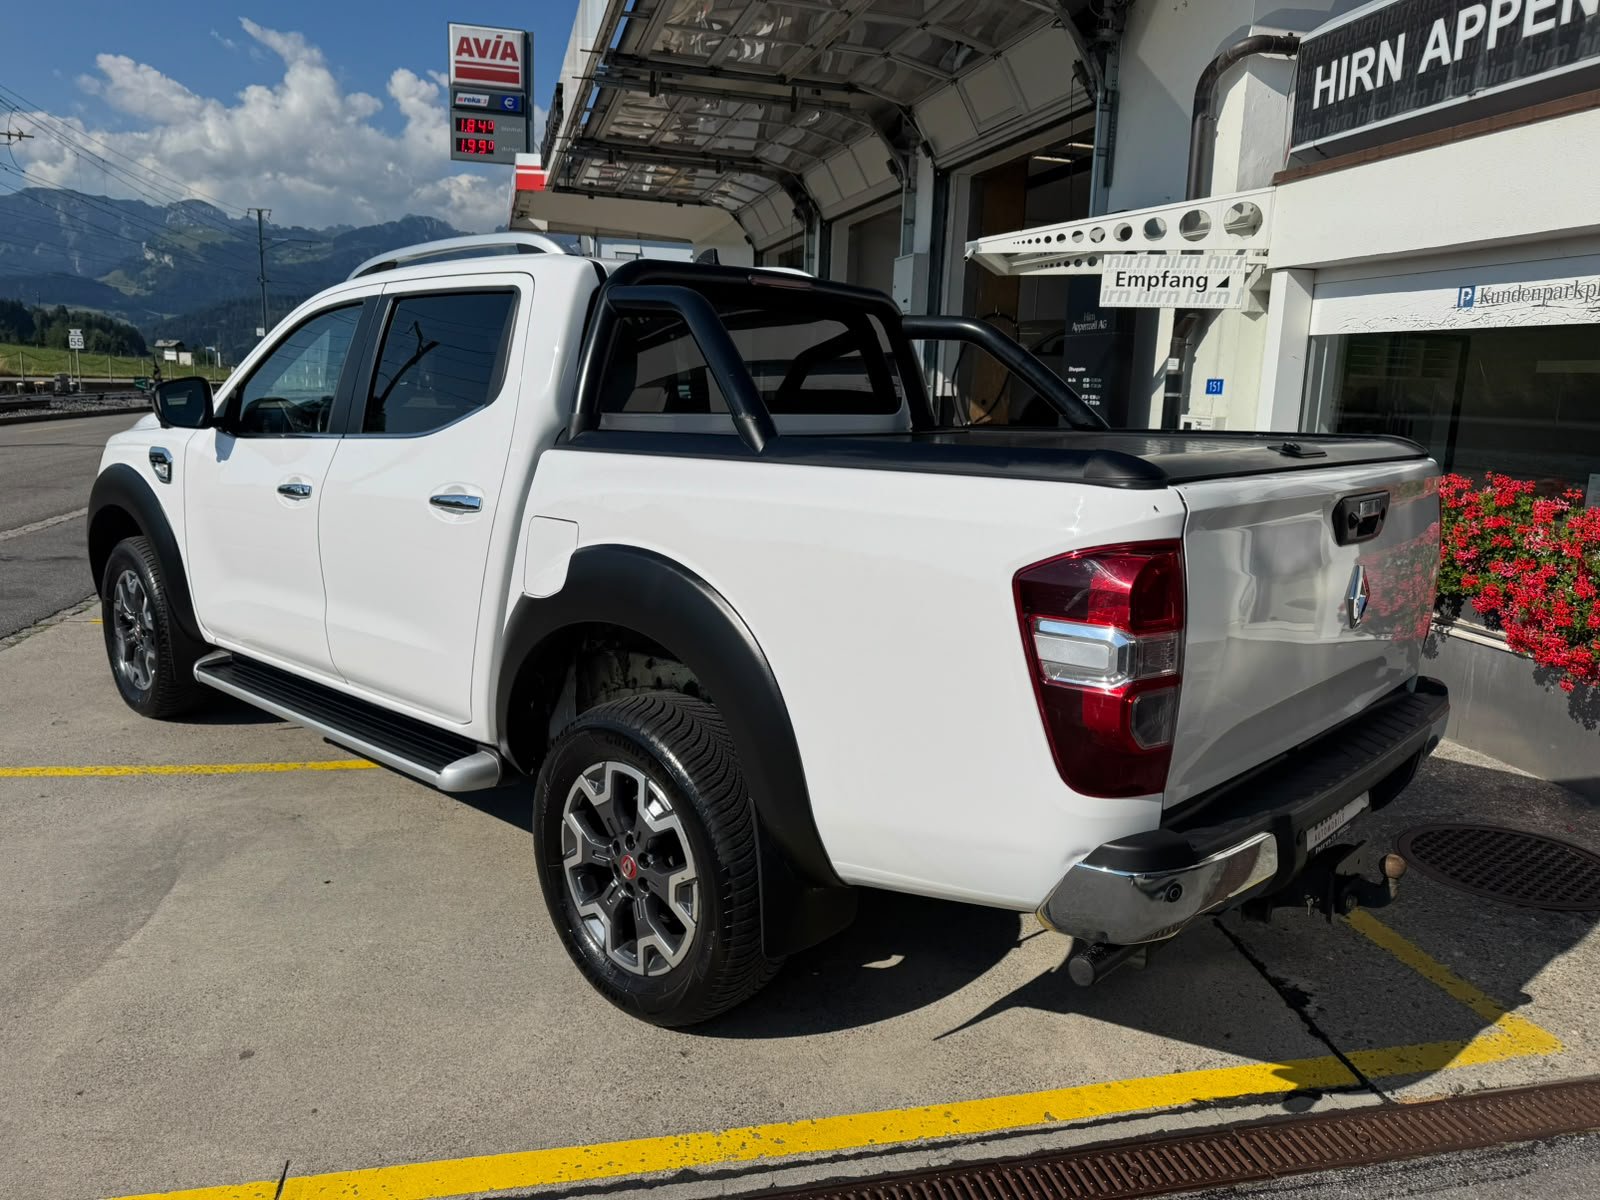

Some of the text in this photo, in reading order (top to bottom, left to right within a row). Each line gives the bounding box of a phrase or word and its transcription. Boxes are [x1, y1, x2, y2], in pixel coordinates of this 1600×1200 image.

[1313, 32, 1406, 110] HIRN
[1115, 270, 1209, 293] Empfang
[1101, 285, 1131, 303] irn
[1460, 288, 1473, 307] P
[1098, 319, 1107, 329] AG
[71, 338, 83, 346] 55
[1209, 381, 1221, 392] 151
